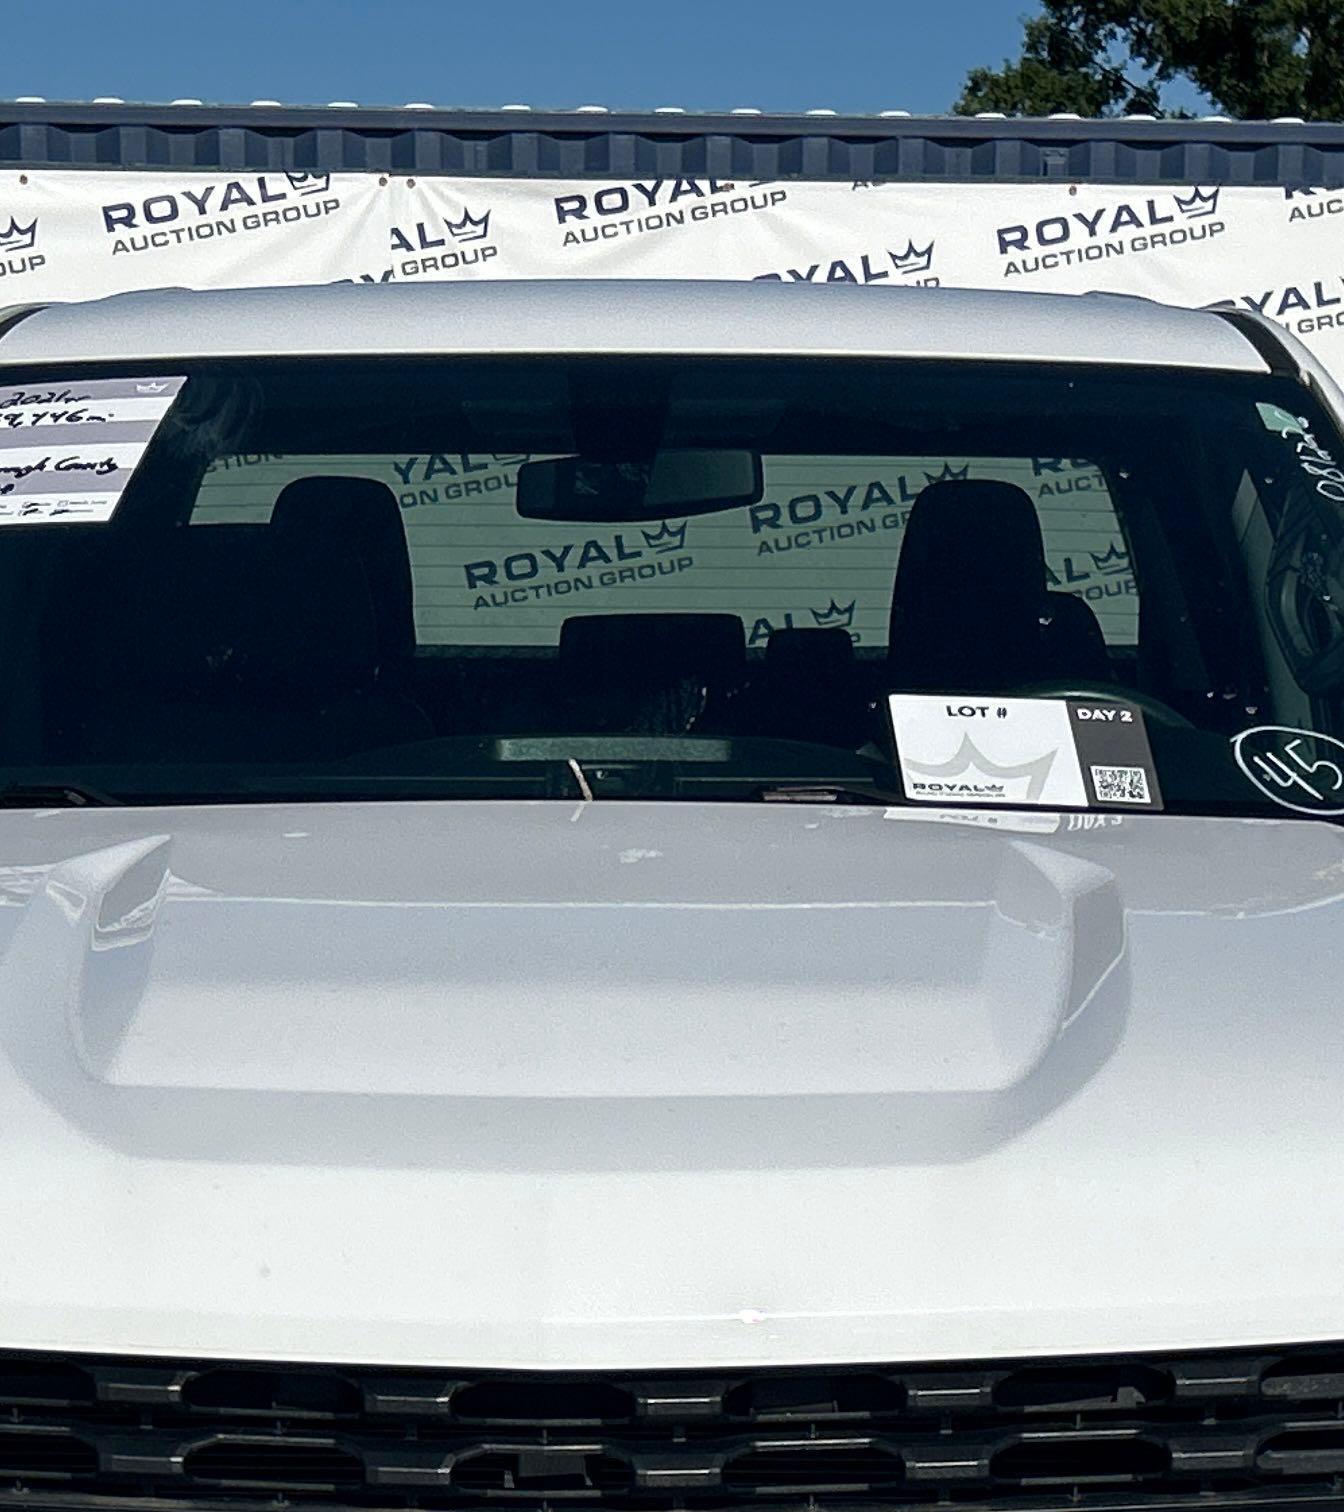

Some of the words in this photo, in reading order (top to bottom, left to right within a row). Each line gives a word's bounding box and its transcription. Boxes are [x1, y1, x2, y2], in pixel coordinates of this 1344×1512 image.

[102, 177, 288, 232] ROYAL
[112, 218, 237, 255] AUCTION
[242, 199, 340, 230] GROUP
[563, 209, 685, 246] AUCTION
[690, 191, 787, 221] GROUP
[996, 200, 1175, 254] ROYAL
[401, 246, 497, 276] GROUP
[1004, 240, 1125, 275] AUCTION
[1130, 221, 1225, 251] GROUP
[464, 535, 643, 589] ROYAL
[757, 517, 876, 556] AUCTION
[473, 575, 593, 611] AUCTION
[598, 556, 693, 586] GROUP
[946, 705, 989, 718] LOT
[996, 706, 1008, 718] #
[1077, 708, 1117, 721] DAY
[1120, 711, 1133, 723] 2
[1253, 739, 1343, 801] 45
